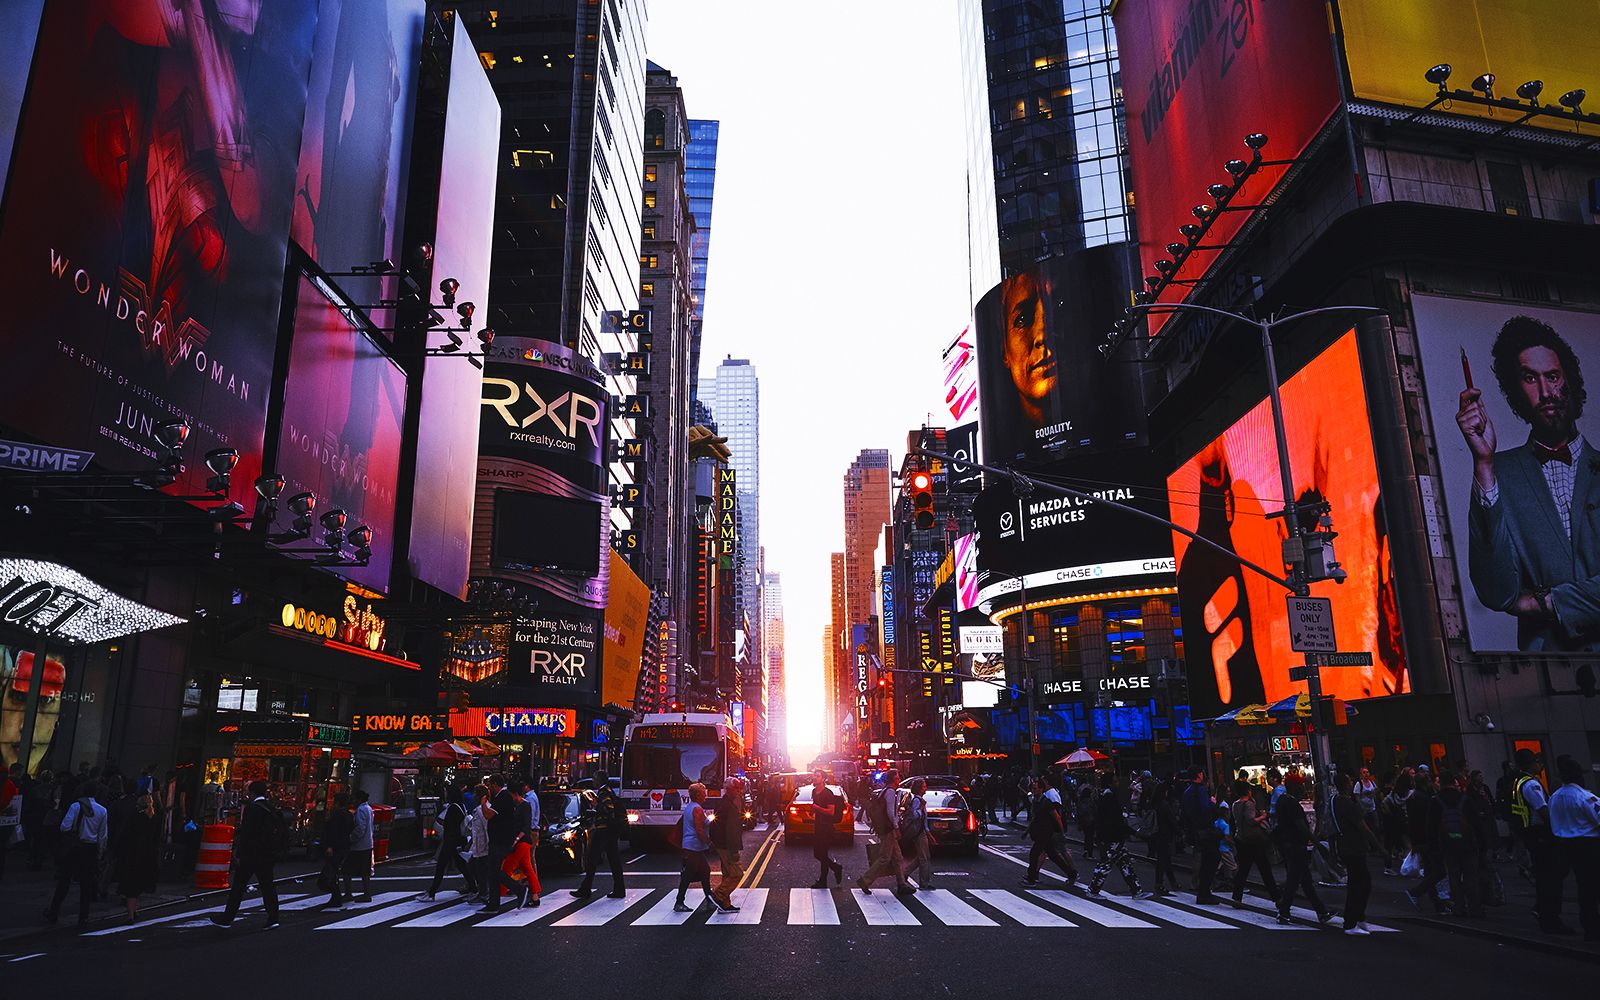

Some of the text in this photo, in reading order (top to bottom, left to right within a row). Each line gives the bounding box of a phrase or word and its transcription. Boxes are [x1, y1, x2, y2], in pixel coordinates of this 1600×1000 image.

[50, 248, 250, 401] WONDER WOMAN
[57, 340, 75, 358] THE
[79, 353, 114, 380] FUTURE
[117, 374, 129, 387] OF
[132, 383, 165, 409] JUSTICE
[167, 402, 195, 425] BEGINS
[481, 377, 599, 448] RXR
[627, 314, 645, 549] CHAMPS
[1035, 421, 1073, 439] EQUALITY.
[509, 431, 577, 451] rxrrealty.com
[0, 444, 81, 472] PRIME
[290, 424, 347, 478] WONDER
[353, 469, 393, 505] WOMAN
[478, 468, 525, 479] SHARP
[720, 469, 735, 553] MADAME
[1029, 496, 1071, 515] MAZDA
[1030, 509, 1086, 530] SERVICES
[1000, 559, 1177, 592] CHASE CHASE CHAS
[1296, 602, 1323, 612] BUSES
[559, 619, 578, 632] New
[579, 622, 594, 634] York
[884, 611, 895, 645] STUDIOS
[1300, 614, 1321, 623] ONLY
[515, 630, 595, 653] for the 21st Century
[940, 609, 954, 685] VICTORY NW
[530, 649, 586, 678] RXR
[1330, 655, 1370, 665] Broadway
[541, 675, 578, 685] REALTY
[857, 654, 868, 719] REGAL
[922, 677, 933, 697] NEW
[1044, 676, 1151, 695] CHASE CHASE
[365, 715, 406, 731] KNOW
[485, 712, 567, 733] CHAMPS
[640, 727, 657, 740] M42
[1273, 737, 1300, 752] SODA
